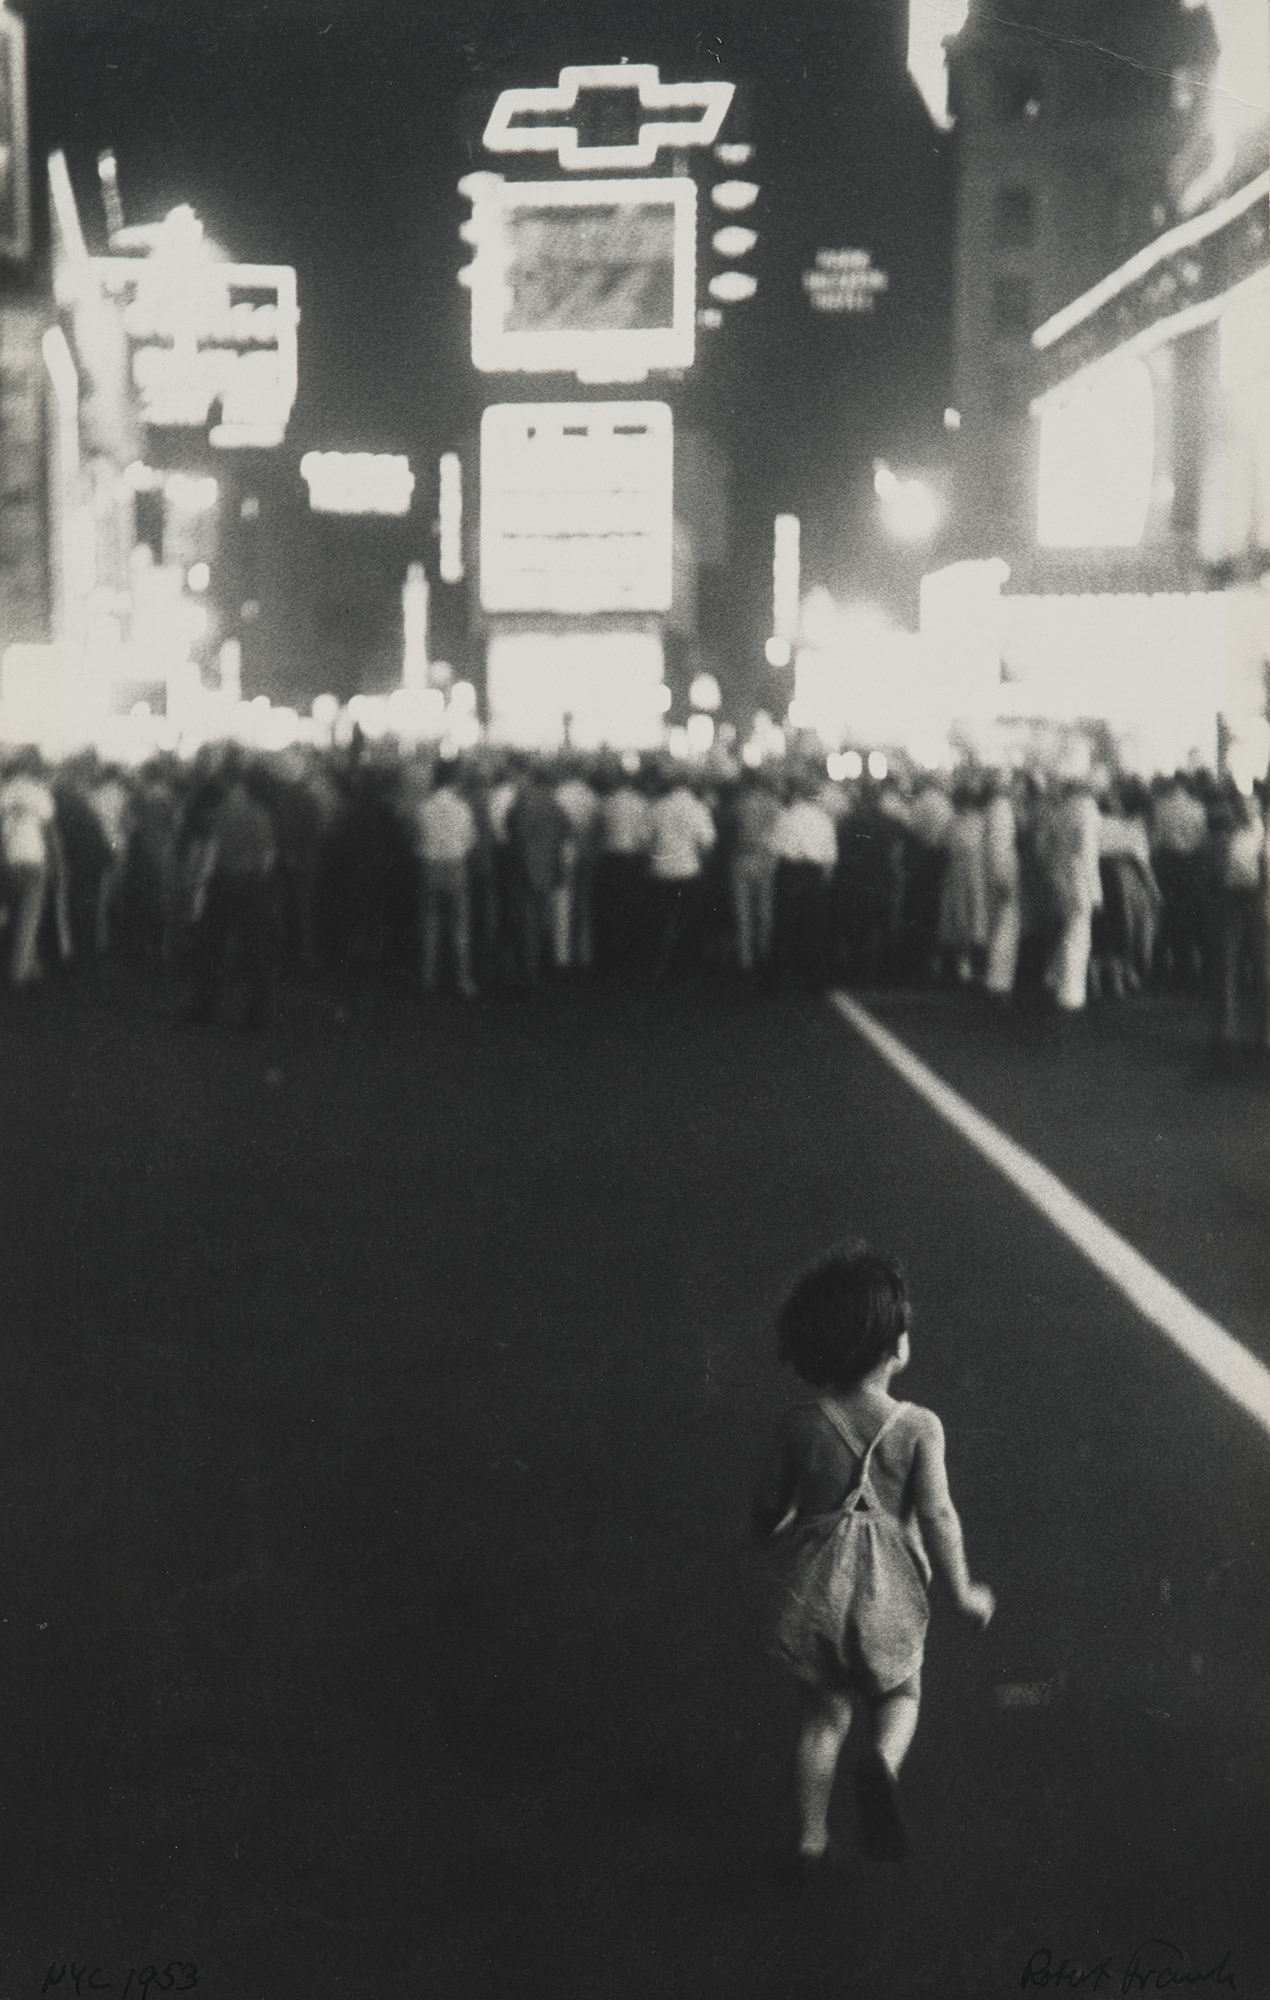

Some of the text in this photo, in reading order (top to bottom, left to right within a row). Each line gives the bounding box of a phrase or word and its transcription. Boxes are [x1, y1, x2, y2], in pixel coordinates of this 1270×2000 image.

[41, 1961, 199, 2000] NYC 1953
[1021, 1938, 1237, 1995] Robert Frank
